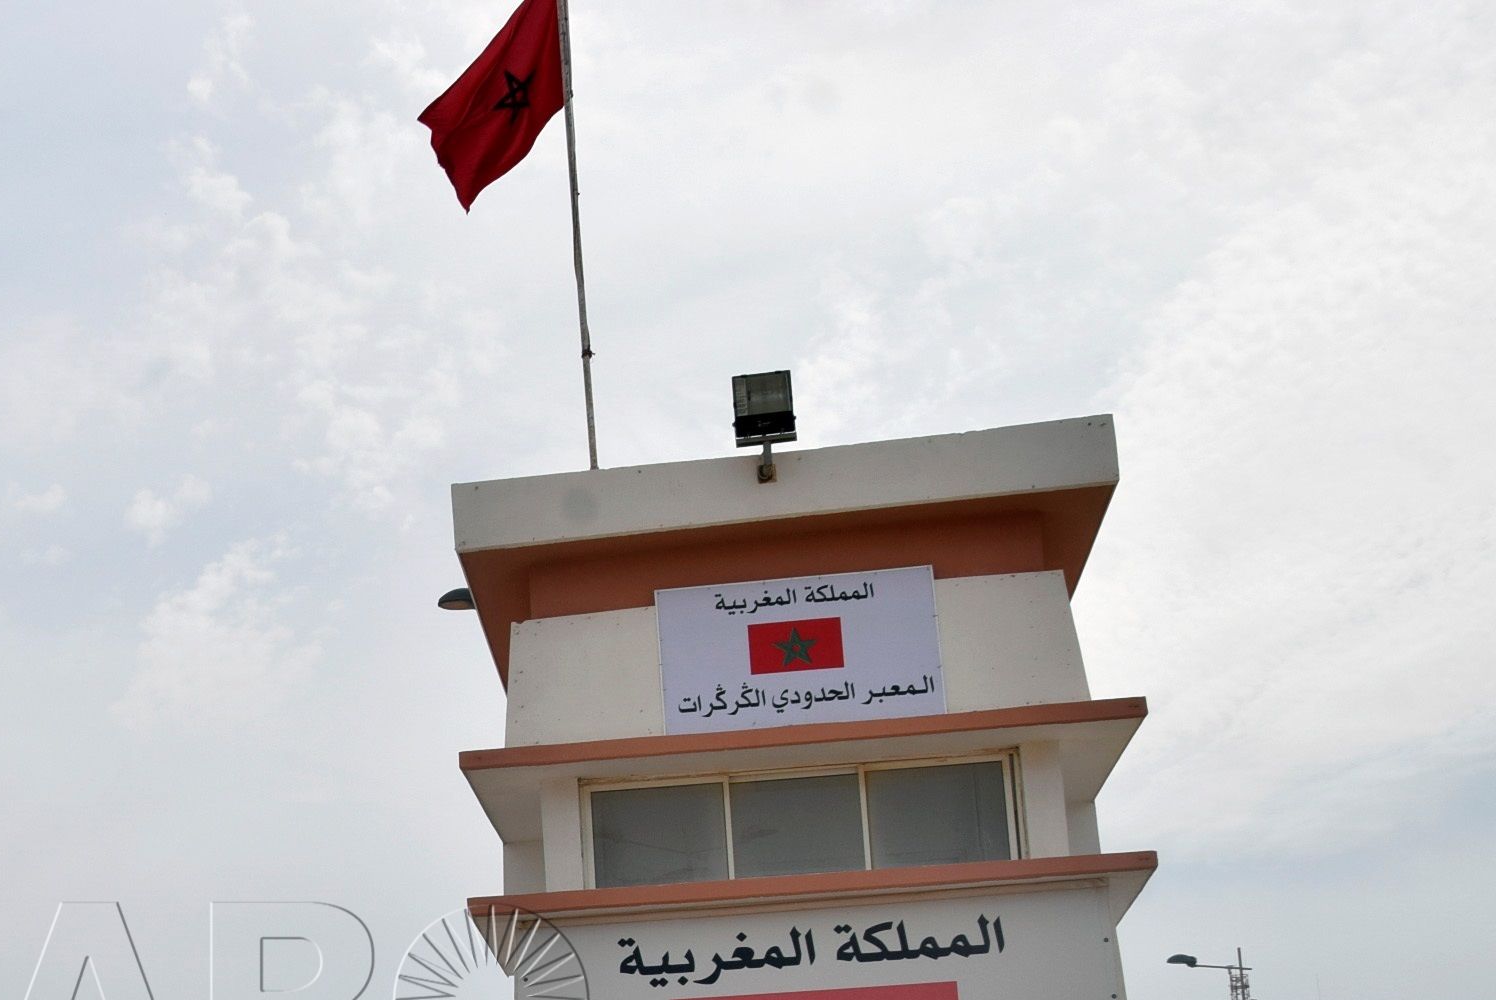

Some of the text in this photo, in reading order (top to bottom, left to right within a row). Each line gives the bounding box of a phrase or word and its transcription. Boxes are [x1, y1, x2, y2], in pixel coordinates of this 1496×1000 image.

[714, 582, 875, 616] المملكة المغربية
[771, 682, 856, 714] الحدودي
[862, 675, 935, 705] المعبر
[617, 914, 1005, 988] المملكة المغربية
